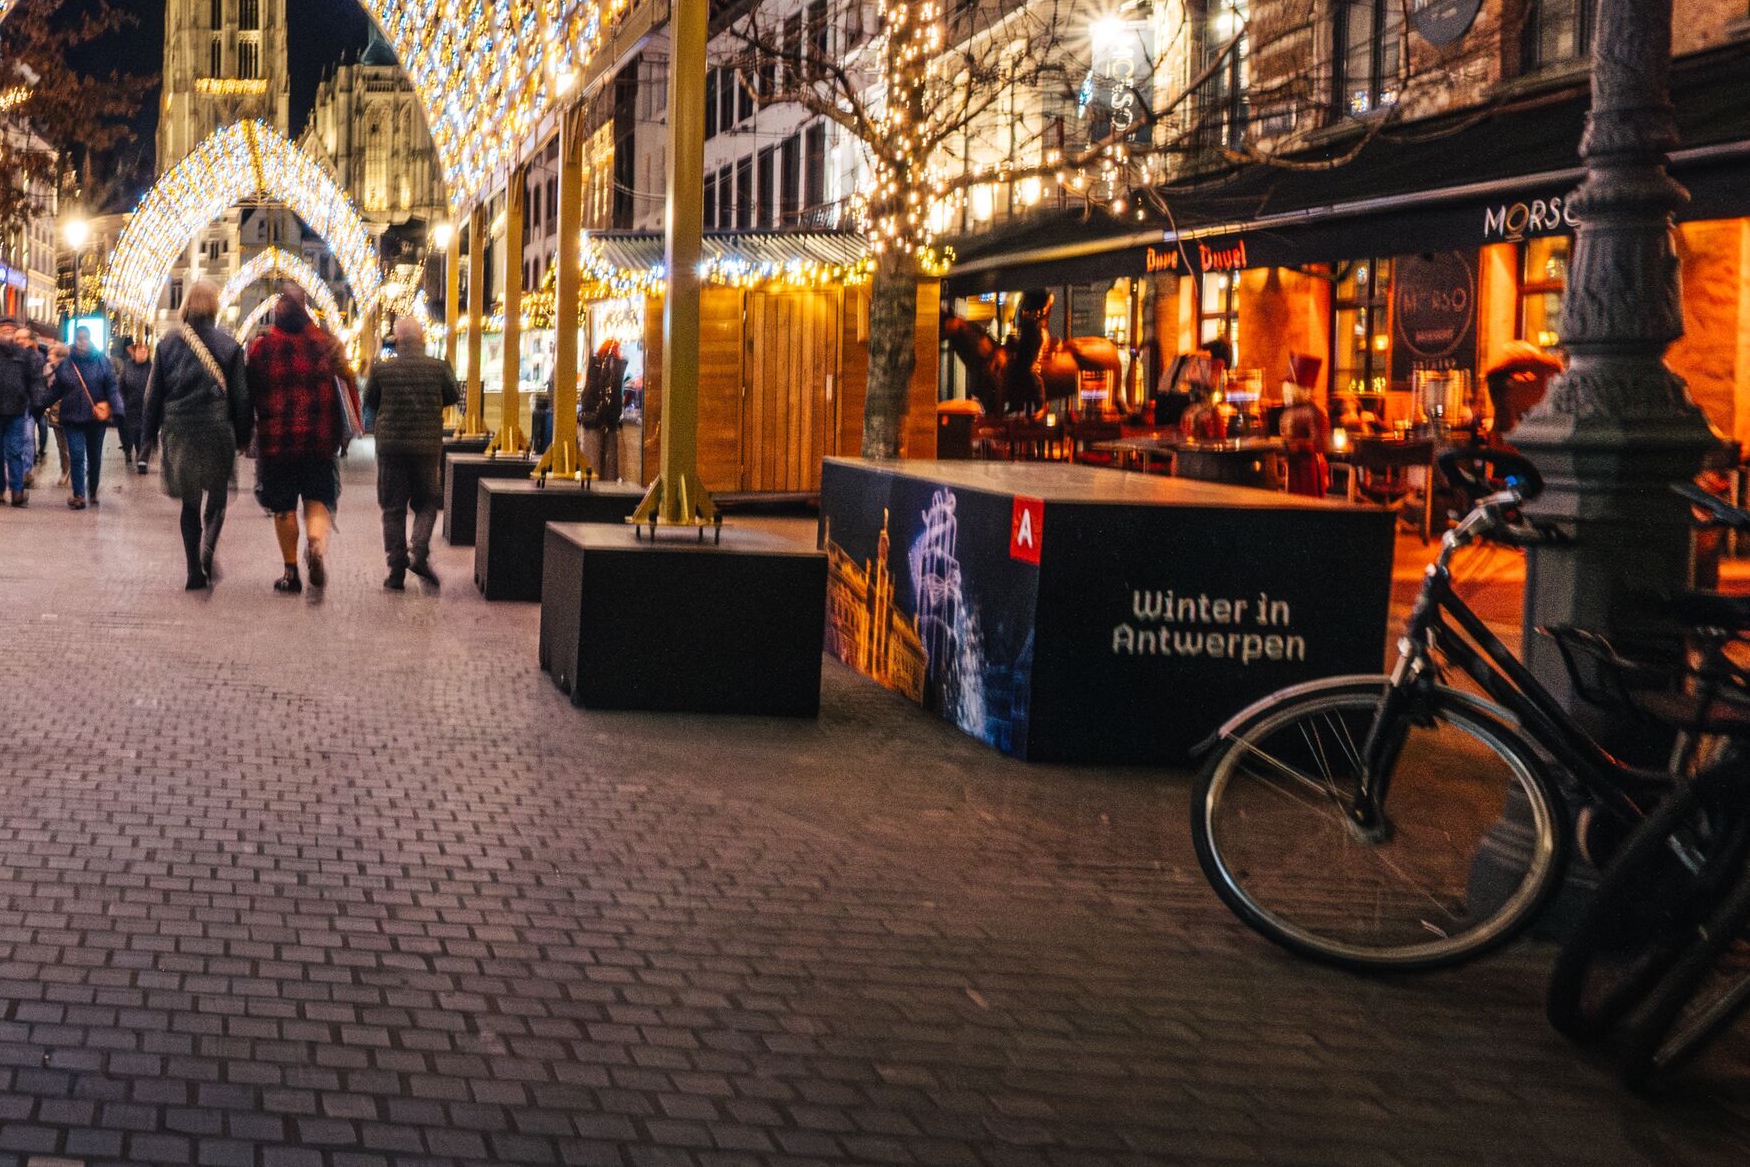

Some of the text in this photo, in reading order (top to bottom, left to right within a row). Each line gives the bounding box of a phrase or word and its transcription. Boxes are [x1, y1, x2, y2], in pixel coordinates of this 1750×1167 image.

[1199, 239, 1247, 273] Duvel
[1017, 508, 1033, 548] A
[1133, 590, 1290, 625] Winter in
[1112, 623, 1305, 665] Antwerpen
